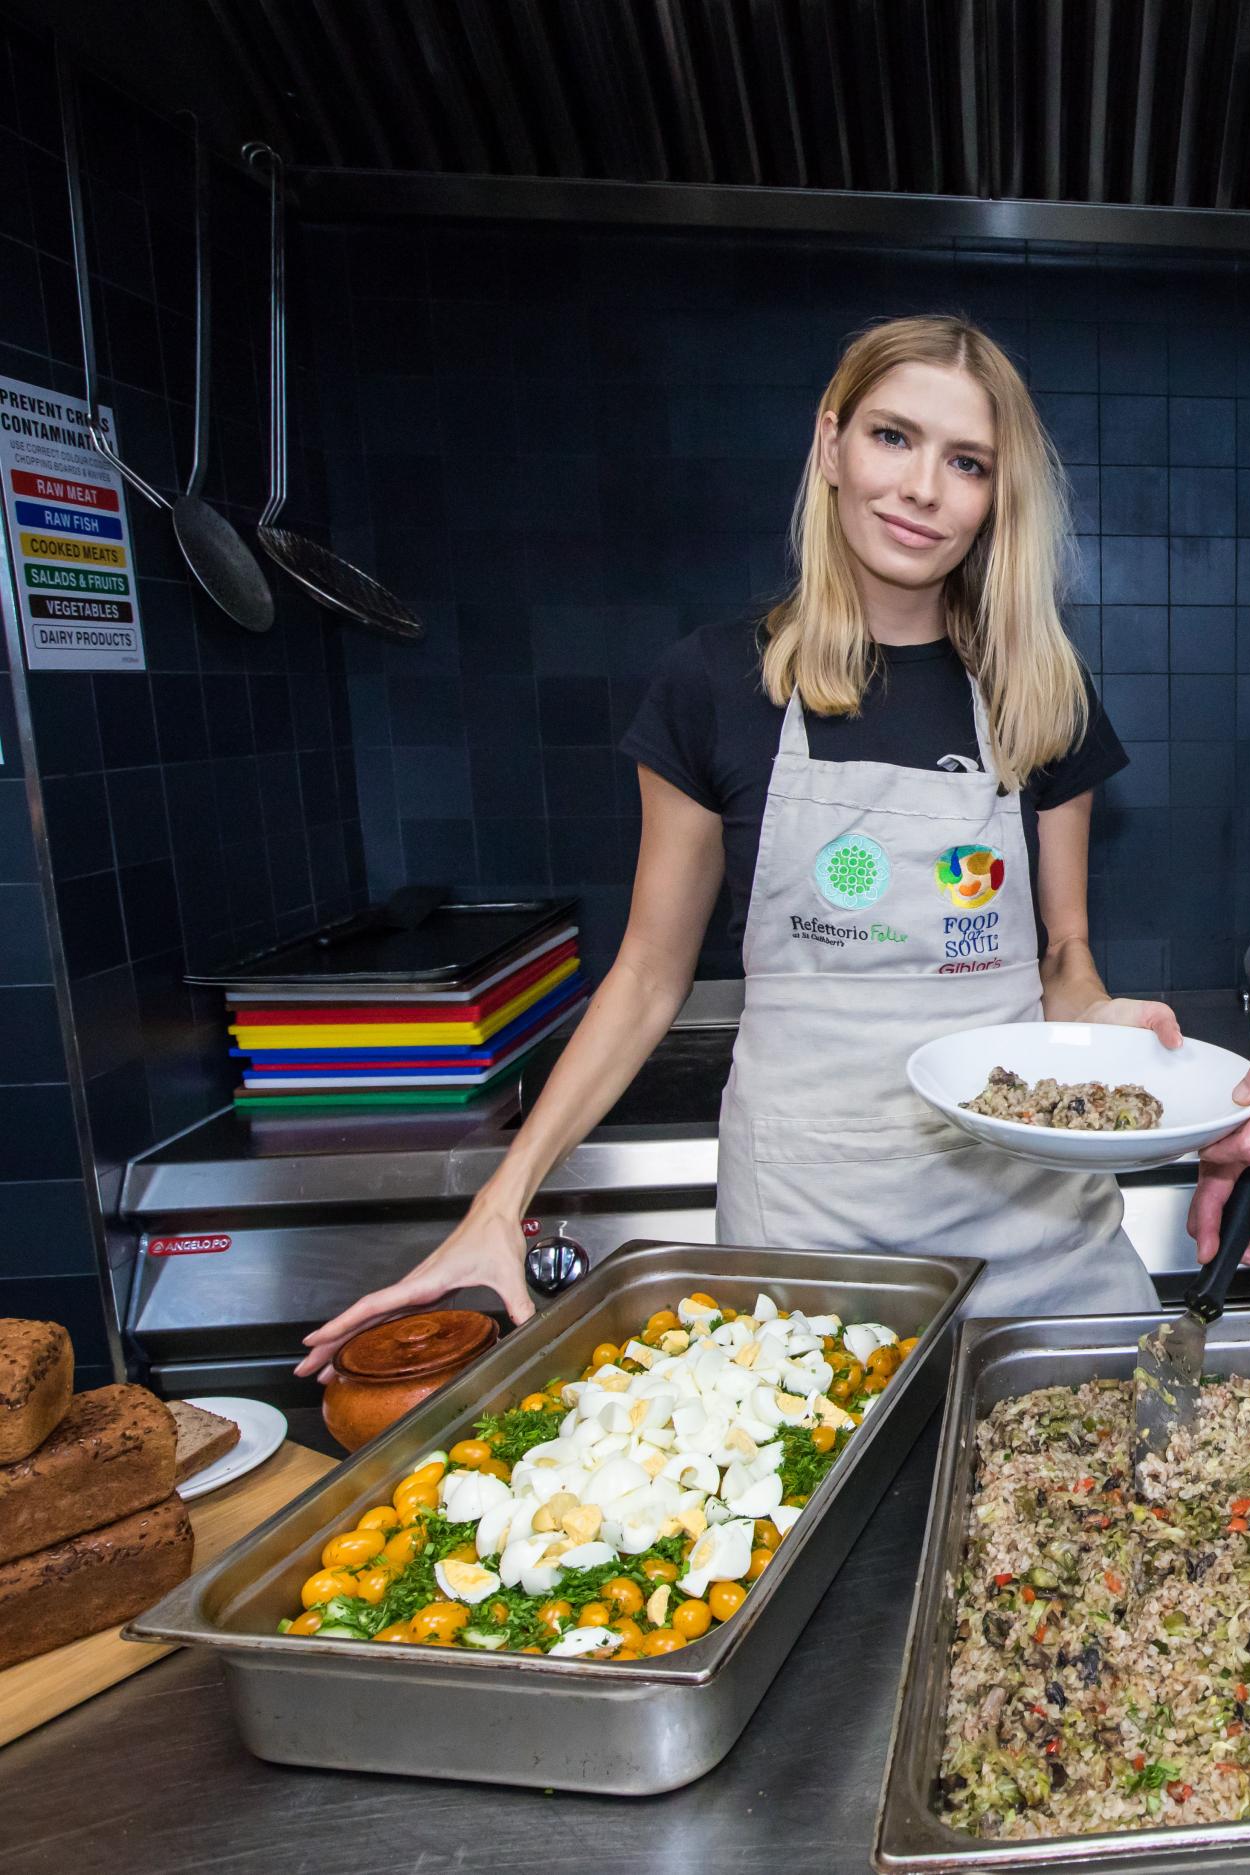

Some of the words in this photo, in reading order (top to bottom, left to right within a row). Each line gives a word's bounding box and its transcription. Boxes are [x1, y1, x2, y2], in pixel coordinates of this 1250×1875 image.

[0, 388, 62, 420] PREVENT
[36, 479, 64, 498] RAW
[67, 483, 97, 504] MEAT
[44, 510, 71, 528] RAW
[74, 515, 99, 533] FISH
[30, 538, 80, 559] COOKED
[83, 547, 118, 563] MEATS
[31, 568, 76, 587] SALADS
[79, 575, 86, 588] &
[88, 576, 125, 591] FRUITS
[46, 600, 119, 619] VEGETABLES
[40, 629, 73, 646] DAIRY
[76, 632, 132, 646] PRODUCTS
[790, 915, 868, 941] Refettorio
[943, 912, 998, 934] FOOD
[960, 930, 984, 945] for
[165, 1240, 211, 1251] ANGELO
[211, 1238, 229, 1249] PO
